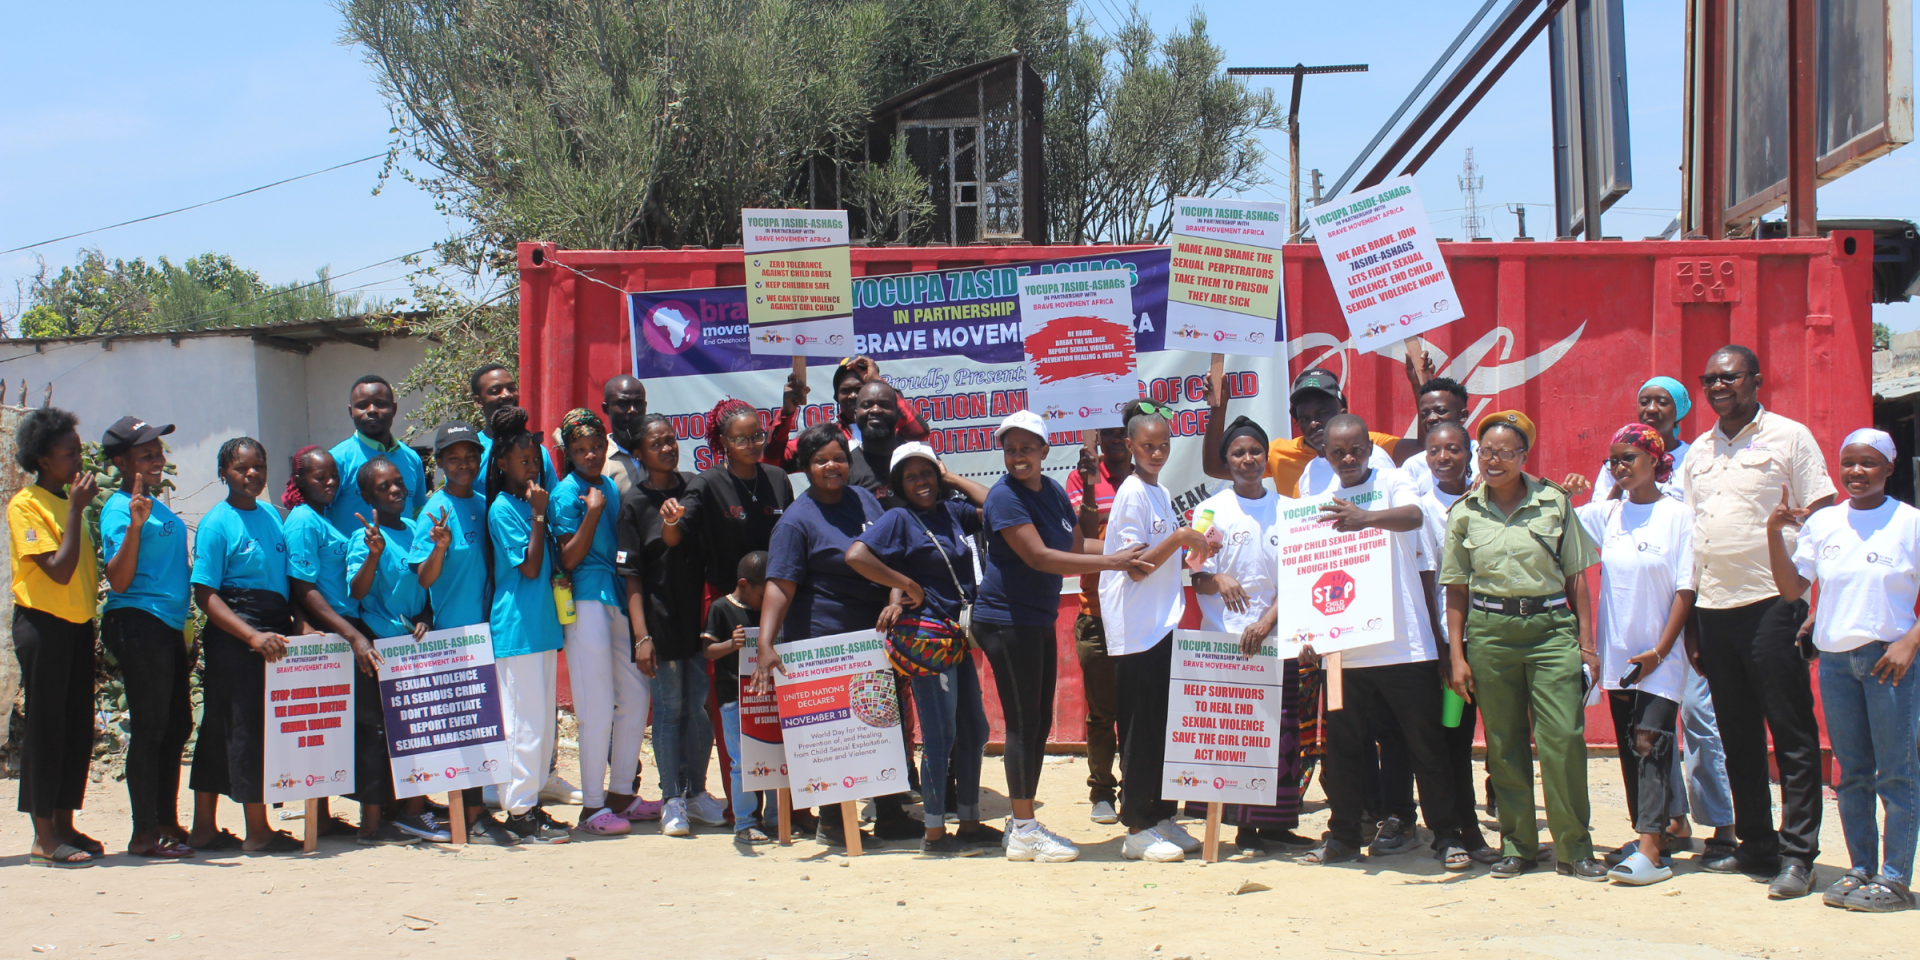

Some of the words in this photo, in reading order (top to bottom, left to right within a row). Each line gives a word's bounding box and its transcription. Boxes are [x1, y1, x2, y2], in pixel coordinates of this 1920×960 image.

[1180, 206, 1212, 217] YOCUPA
[1214, 208, 1279, 222] 7ASIDE-ASHAGs
[1315, 206, 1348, 227] YOCUPA
[1348, 185, 1412, 215] 7ASIDE-ASHAGs
[748, 217, 779, 227] YOCUPA
[781, 218, 843, 229] 7ASIDE-ASHAGs
[1207, 226, 1241, 234] MOVEMENT
[1178, 243, 1202, 254] NAME
[1204, 246, 1222, 257] AND
[1224, 249, 1254, 261] SHAME
[1257, 252, 1272, 264] THE
[1336, 250, 1351, 263] WE
[1352, 244, 1368, 257] ARE
[1398, 226, 1416, 240] JOIN
[786, 261, 822, 269] TOLERANCE
[1349, 241, 1414, 271] 7ASIDE-ASHAGS
[762, 269, 789, 277] AGAINST
[811, 270, 832, 278] ABUSE
[1173, 257, 1204, 270] SEXUAL
[1208, 262, 1274, 280] PERPETRATORS
[1348, 272, 1367, 286] LETS
[1368, 263, 1392, 280] FIGHT
[1393, 252, 1424, 269] SEXUAL
[1025, 283, 1059, 296] YOCUPA
[1060, 279, 1125, 292] 7ASIDE-ASHAGs
[1174, 273, 1195, 284] TAKE
[1197, 276, 1220, 288] THEM
[1223, 280, 1233, 289] TO
[1236, 281, 1268, 294] PRISON
[1348, 278, 1388, 299] VIOLENCE
[1390, 270, 1407, 284] END
[1408, 262, 1433, 278] CHILD
[852, 273, 938, 308] YOCUPA
[1188, 290, 1208, 302] THEY
[1210, 294, 1227, 304] ARE
[1229, 296, 1250, 308] SICK
[1346, 296, 1377, 314] SEXUAL
[1378, 282, 1418, 302] VIOLENCE
[1418, 271, 1445, 287] NOW!!
[893, 308, 910, 324] IN
[914, 301, 1015, 323] PARTNERSHIP
[854, 330, 927, 355] BRAVE
[935, 322, 1022, 348] MOVEM
[1085, 336, 1106, 344] SILENCE
[1040, 355, 1073, 363] PREVENTION
[1074, 353, 1096, 361] HEALING
[1048, 346, 1068, 355] REPORT
[1070, 345, 1089, 353] SEXUAL
[1090, 343, 1115, 352] VIOLENCE
[881, 369, 950, 394] Proudly
[1150, 377, 1182, 404] OF
[1283, 545, 1302, 554] STOP
[1304, 539, 1327, 550] CHILD
[1329, 533, 1356, 546] SEXUAL
[1359, 527, 1383, 540] ABUSE
[1282, 557, 1296, 566] YOU
[1298, 554, 1311, 563] ARE
[1314, 547, 1342, 560] KILLING
[1344, 544, 1357, 555] THE
[1359, 538, 1386, 551] FUTURE
[1297, 562, 1328, 575] ENOUGH
[1330, 560, 1338, 569] IS
[1340, 554, 1370, 567] ENOUGH
[1314, 581, 1353, 604] STOP
[1325, 605, 1345, 614] ABUSE
[1326, 600, 1344, 608] CHILD
[381, 643, 416, 658] YOCUPA
[418, 634, 486, 653] 7ASIDE-ASHAGs
[815, 639, 883, 659] 7ASIDE-ASHAGs
[1178, 639, 1211, 652] YOCUPA
[395, 677, 431, 692] SEXUAL
[432, 669, 478, 686] VIOLENCE
[391, 696, 402, 707] IS
[403, 695, 411, 705] A
[412, 688, 453, 705] SERIOUS
[455, 683, 486, 697] CRIME
[783, 691, 809, 701] UNITED
[812, 685, 844, 696] NATIONS
[1184, 684, 1206, 696] HELP
[1209, 686, 1264, 700] SURVIVORS
[400, 706, 428, 720] DON'T
[430, 698, 482, 716] NEGOTIATE
[798, 696, 835, 708] DECLARES
[1195, 700, 1207, 712] TO
[1210, 702, 1232, 714] HEAL
[1235, 703, 1253, 715] END
[409, 719, 447, 734] REPORT
[449, 714, 478, 728] EVERY
[785, 712, 835, 727] NOVEMBER
[838, 710, 847, 718] 18
[1182, 716, 1217, 728] SEXUAL
[1219, 718, 1264, 731] VIOLENCE
[396, 736, 432, 751] SEXUAL
[433, 725, 498, 746] HARASSMENT
[798, 740, 832, 750] Prevention
[857, 731, 882, 740] Healing
[811, 731, 830, 739] World
[832, 729, 844, 737] Day
[1172, 731, 1196, 743] SAVE
[1198, 733, 1215, 744] THE
[1218, 734, 1239, 746] GIRL
[1242, 736, 1270, 748] CHILD
[813, 756, 832, 764] Abuse
[848, 749, 876, 758] Violence
[830, 745, 850, 753] Sexual
[1194, 748, 1214, 760] ACT
[1216, 750, 1246, 762] NOW!!
